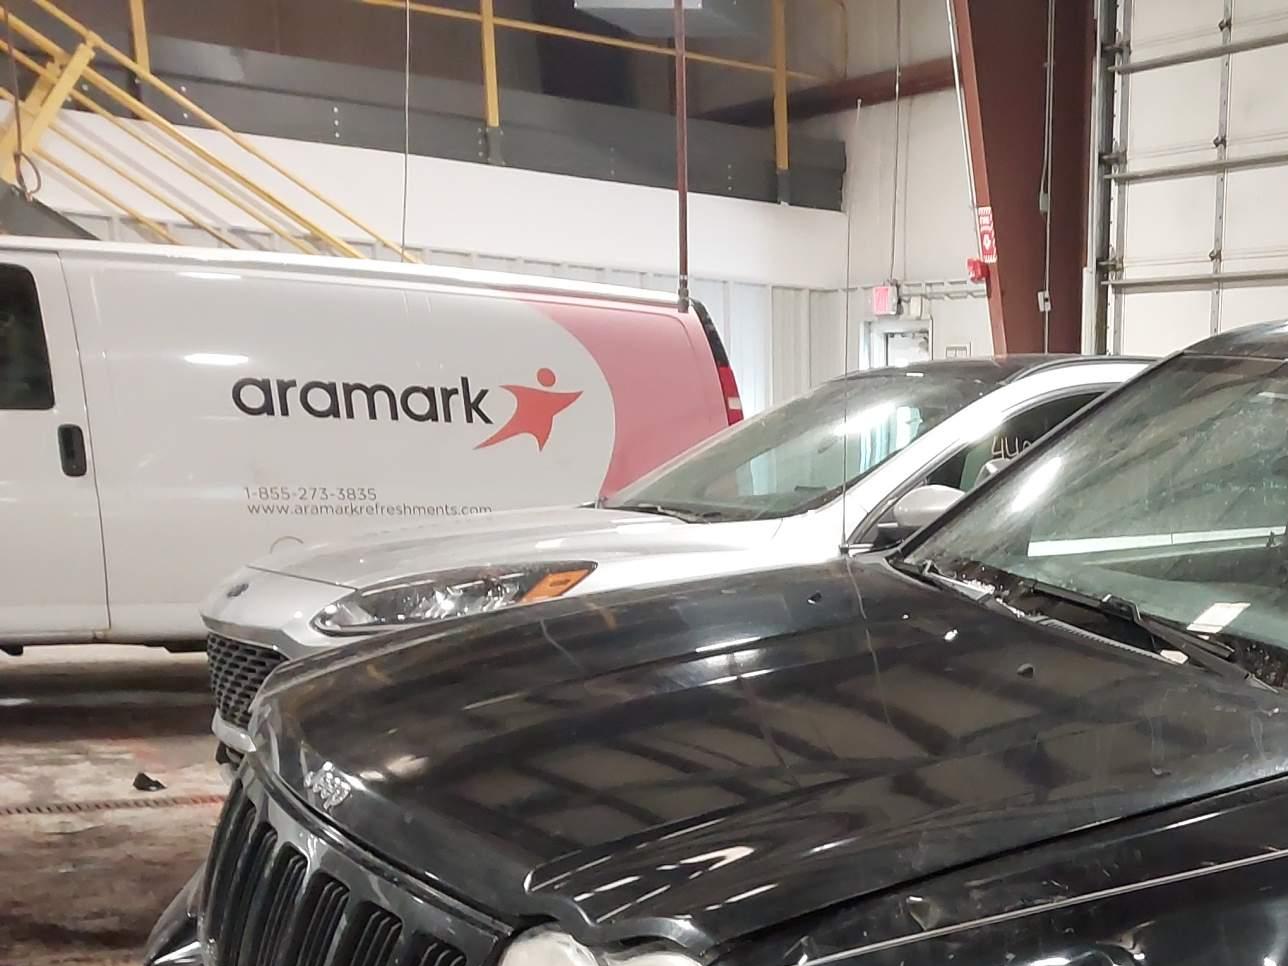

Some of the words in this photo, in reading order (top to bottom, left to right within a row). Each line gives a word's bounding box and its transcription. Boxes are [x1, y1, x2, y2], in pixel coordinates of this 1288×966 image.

[232, 376, 493, 424] aramark
[244, 486, 378, 501] 1-855-273-3835
[247, 501, 493, 517] www.aramarkrefreshments.com
